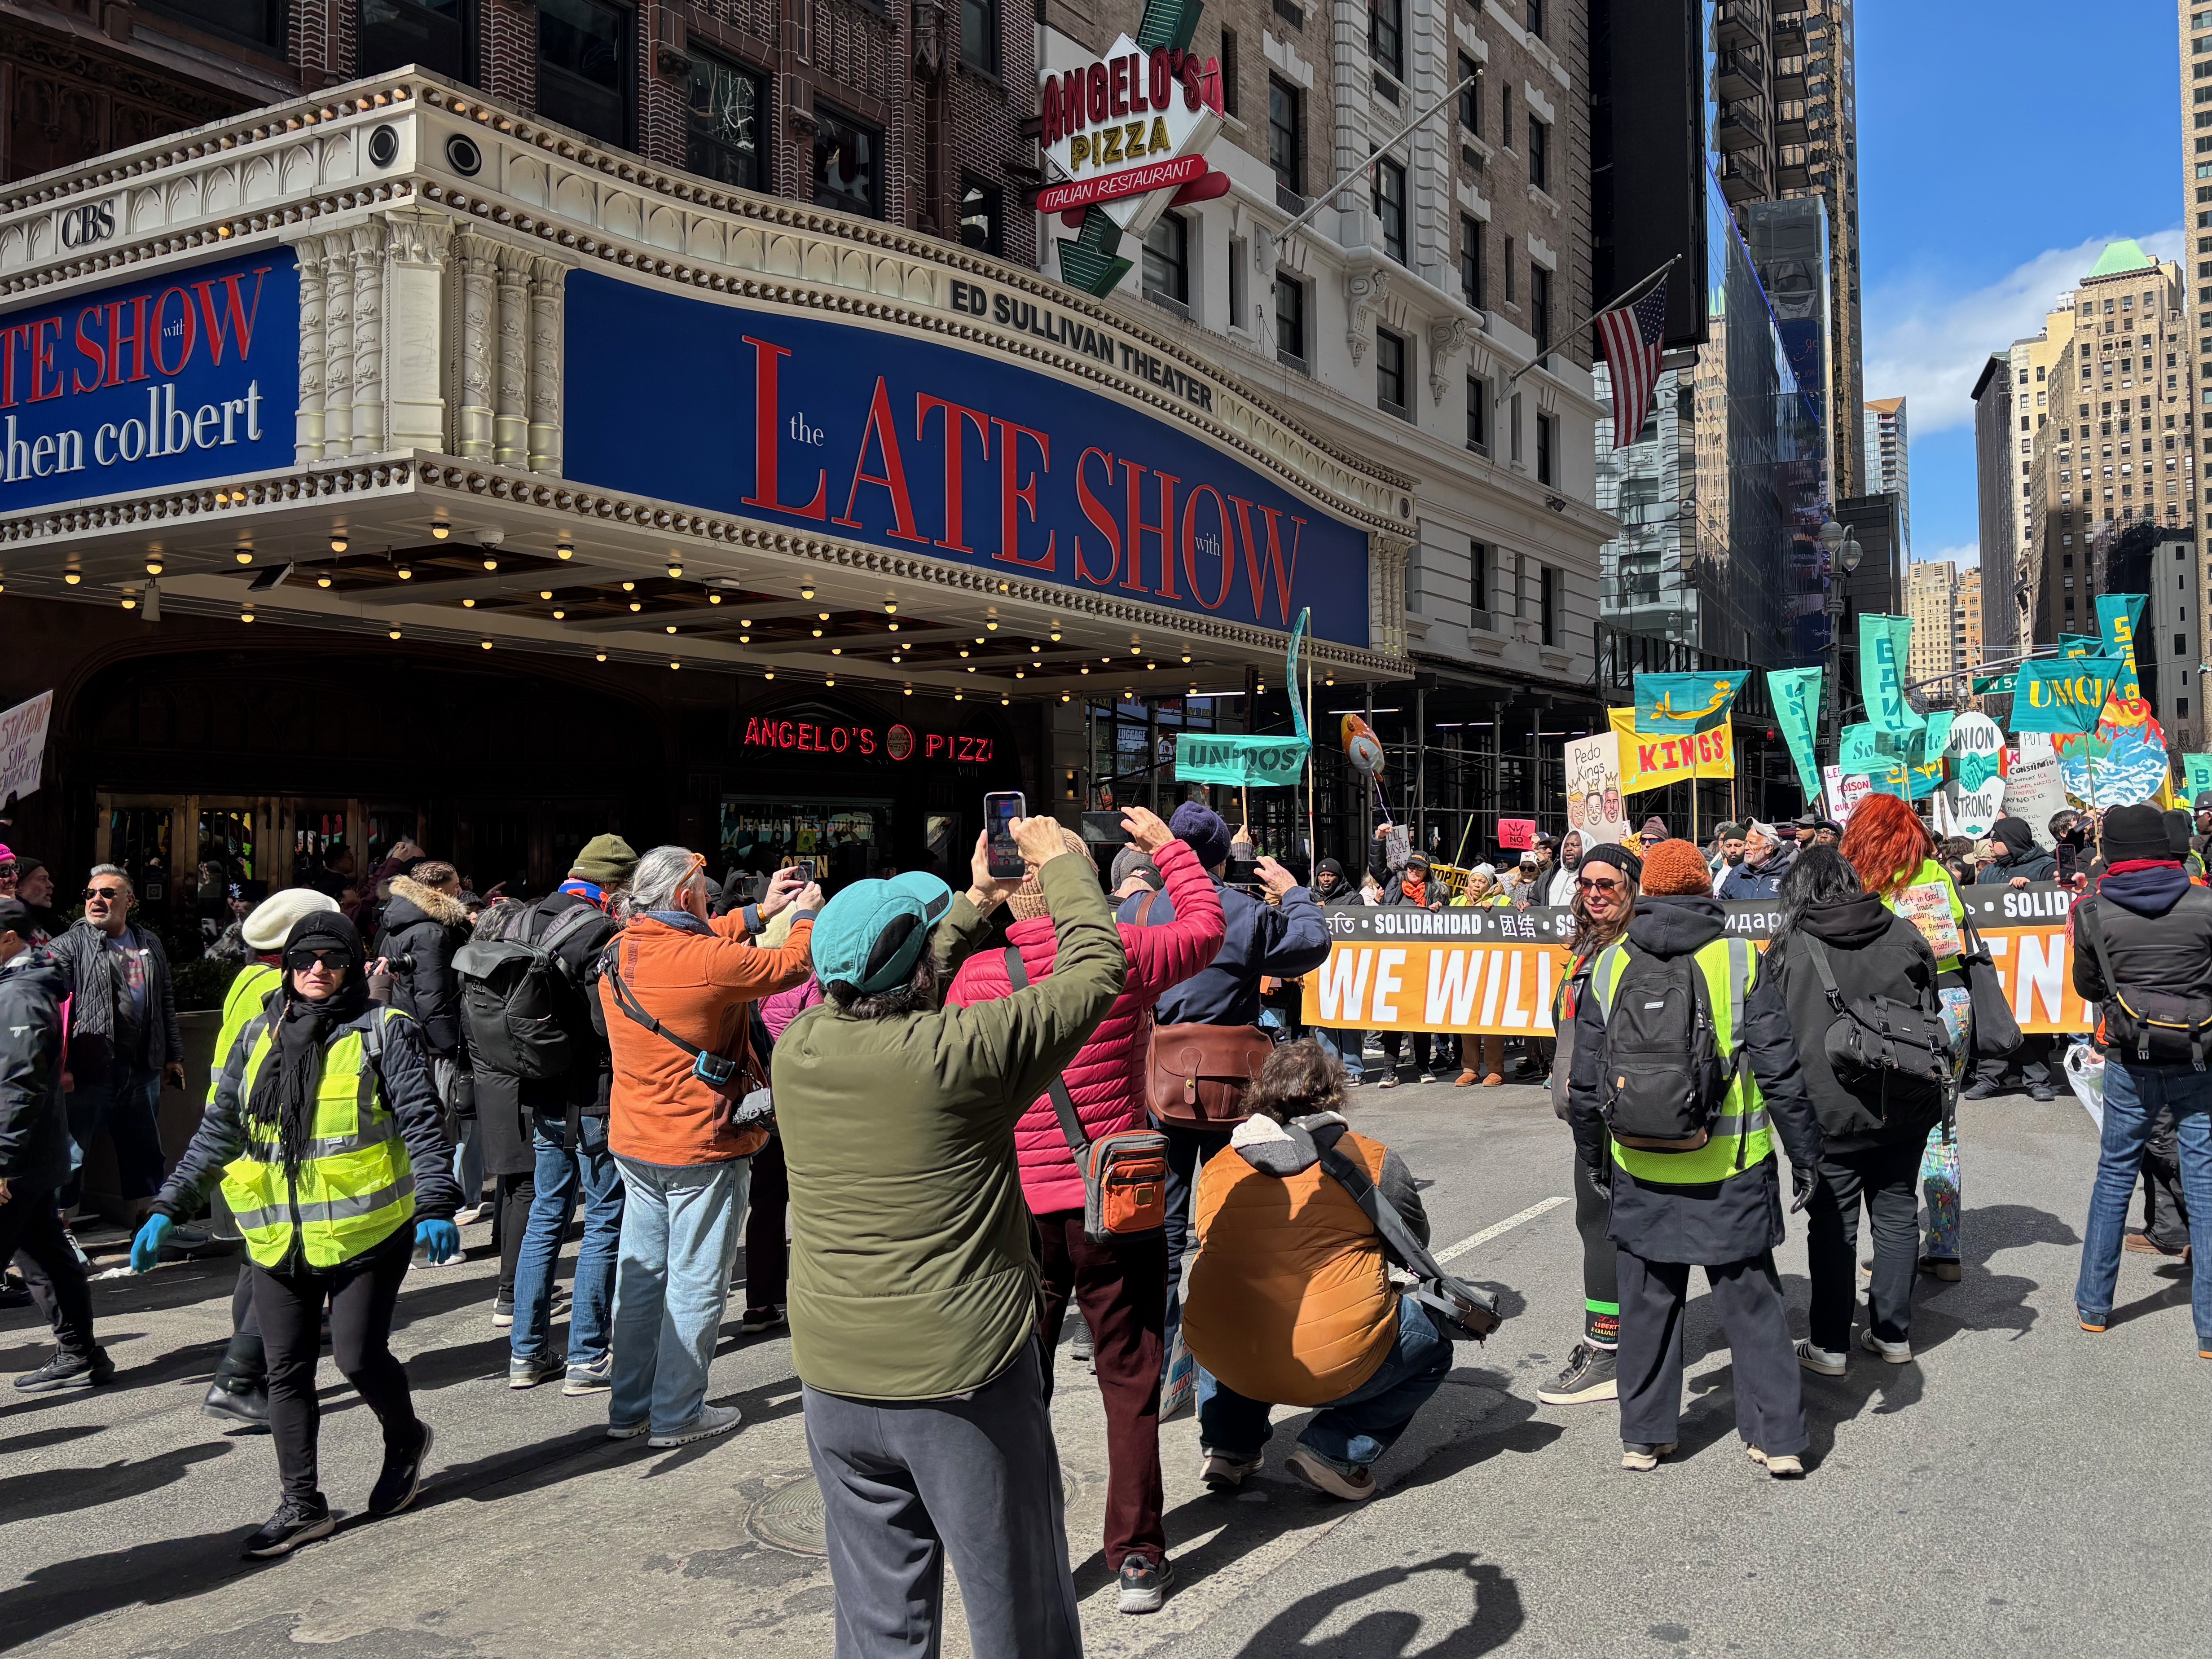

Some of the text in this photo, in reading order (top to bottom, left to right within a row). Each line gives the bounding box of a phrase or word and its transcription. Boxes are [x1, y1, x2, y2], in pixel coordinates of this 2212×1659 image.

[1042, 46, 1203, 148] ANGELO'S
[1071, 116, 1171, 171] PIZZA
[1045, 159, 1194, 207] ITALIAN RESTAURANT
[62, 198, 115, 250] CBS
[73, 266, 272, 395] SHOW
[163, 319, 185, 338] with
[950, 279, 1213, 412] ED SULLIVAN THEATER
[0, 379, 264, 482] hen colbert
[789, 411, 825, 448] the
[741, 335, 1307, 625] LATE SHOW
[1194, 532, 1222, 558] with
[1988, 680, 1998, 690] W
[744, 717, 877, 755] ANGELO'S
[1118, 728, 1146, 741] LUGGAGE
[1949, 727, 1994, 751] UNION
[2024, 733, 2041, 745] PUT
[926, 734, 993, 762] PIZZ
[1575, 742, 1601, 765] Pedo
[1638, 730, 1724, 773] KINGS
[1577, 760, 1606, 782] Kings
[1834, 803, 1850, 811] OUR
[1953, 793, 1992, 818] STRONG
[781, 855, 828, 879] ON
[1432, 867, 1452, 880] TOP
[1899, 888, 1939, 906] Get in Good
[1914, 903, 1933, 911] Trouble
[2003, 891, 2077, 917] SOLID
[1375, 914, 1482, 934] SOLIDARIDAD
[1500, 914, 1536, 938] 团结
[1929, 923, 1949, 932] Redeem
[1931, 913, 1951, 922] Trouble
[1319, 948, 1407, 1022] WE
[1423, 950, 1554, 1028] WILL
